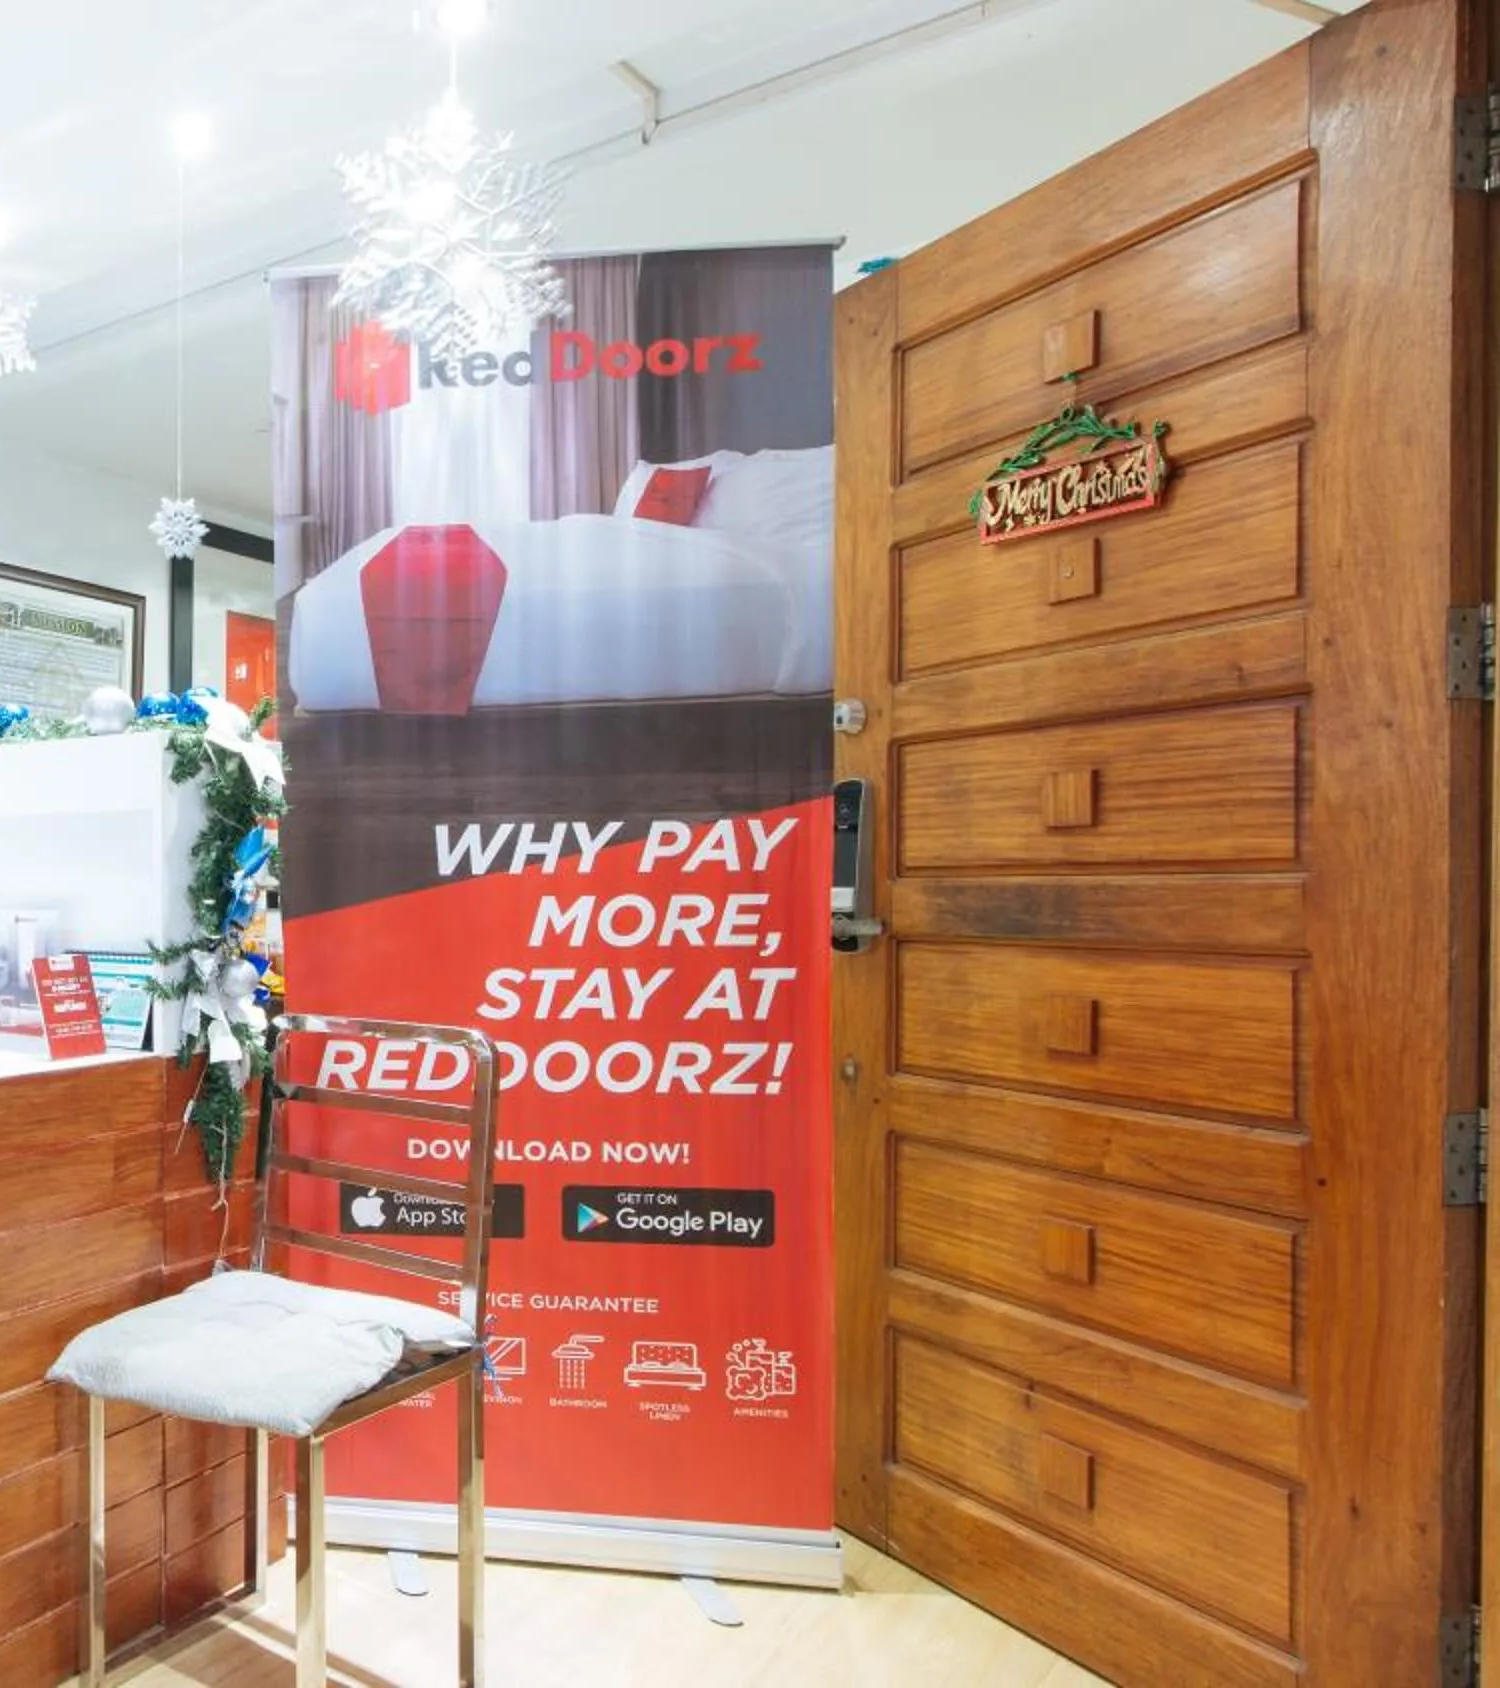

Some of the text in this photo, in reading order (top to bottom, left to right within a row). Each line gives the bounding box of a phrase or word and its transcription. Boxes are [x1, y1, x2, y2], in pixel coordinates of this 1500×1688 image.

[985, 447, 1149, 525] Merry Christmas
[30, 610, 87, 635] MISSION
[435, 818, 798, 876] WHY PAY
[528, 894, 783, 957] MORE,
[476, 968, 797, 1021] STAY AT
[602, 1141, 691, 1165] NOW!
[616, 1192, 677, 1206] GET IT ON
[396, 1206, 437, 1228] App
[616, 1207, 764, 1239] Google Play
[438, 1291, 659, 1314] SEICE GUARANTEE
[549, 1398, 608, 1409] BATHROOM
[639, 1401, 691, 1414] SPOTLESS
[733, 1407, 789, 1419] AMENITIES
